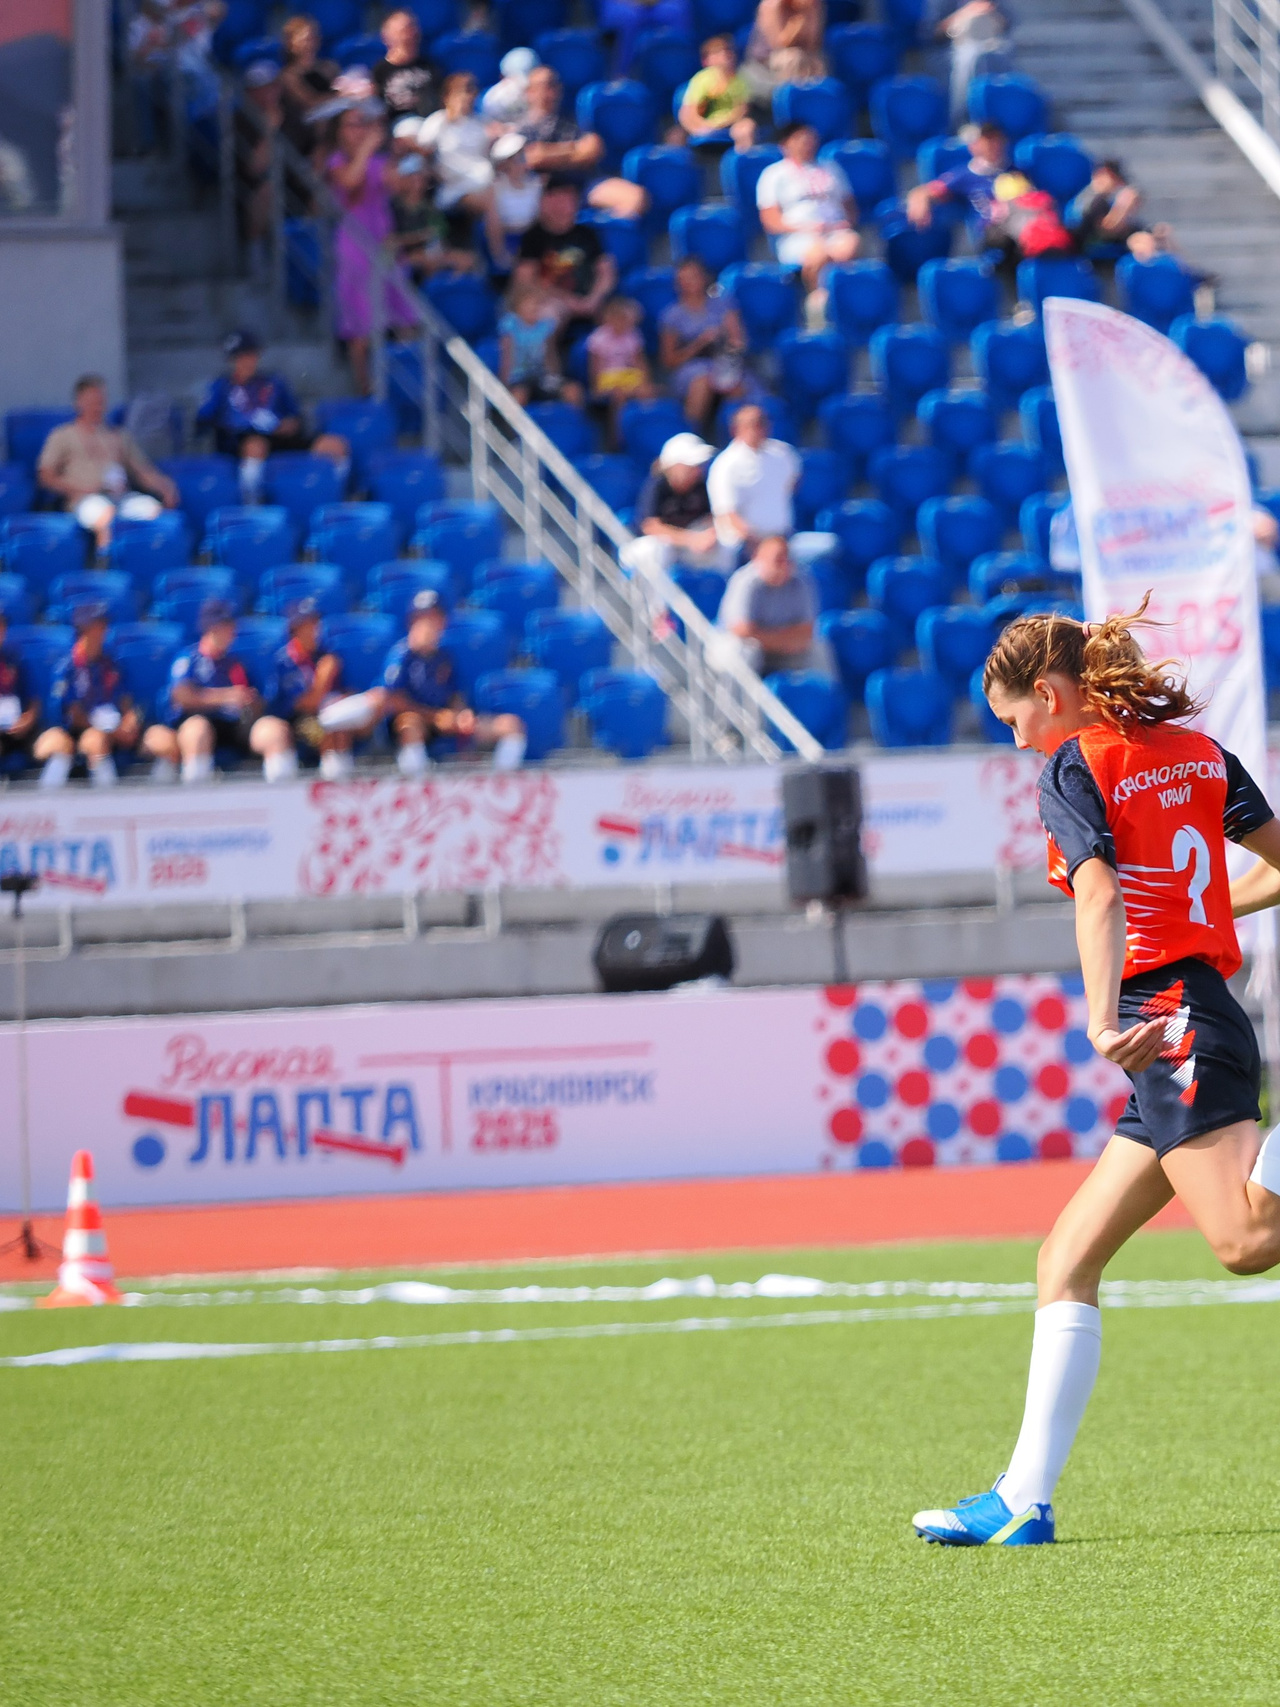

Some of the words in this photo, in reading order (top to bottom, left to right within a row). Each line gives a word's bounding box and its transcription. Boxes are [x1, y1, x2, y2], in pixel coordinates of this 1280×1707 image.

[1157, 782, 1193, 810] КРАЙ
[468, 1071, 657, 1107] КРАСНОЯРСК
[190, 1083, 421, 1162] ЛАПТА
[471, 1109, 560, 1153] 2025
